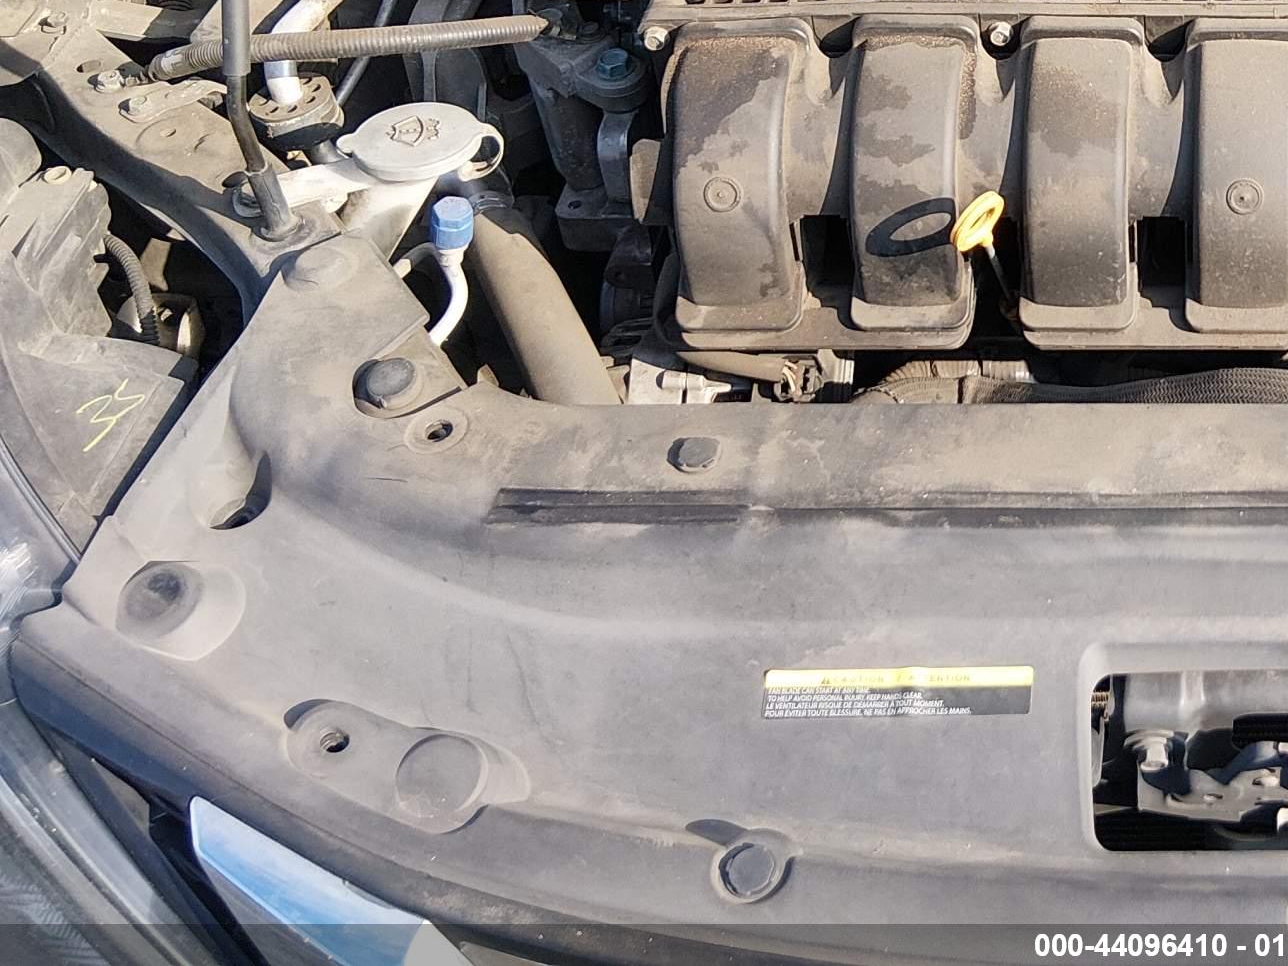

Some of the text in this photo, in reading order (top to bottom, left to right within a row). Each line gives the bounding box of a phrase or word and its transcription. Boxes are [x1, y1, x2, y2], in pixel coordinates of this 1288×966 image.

[768, 694, 777, 702] TO
[793, 694, 812, 702] AVOID
[813, 693, 843, 701] PERSONAL
[882, 692, 901, 700] HANDS
[776, 701, 818, 709] VENTILATEUR
[819, 700, 842, 709] RISQUE
[896, 699, 912, 708] TOUT
[765, 709, 783, 717] POUR
[808, 708, 829, 716] TOUTE
[874, 708, 886, 716] PAS
[897, 707, 936, 715] APPROCHER
[937, 707, 948, 715] LES
